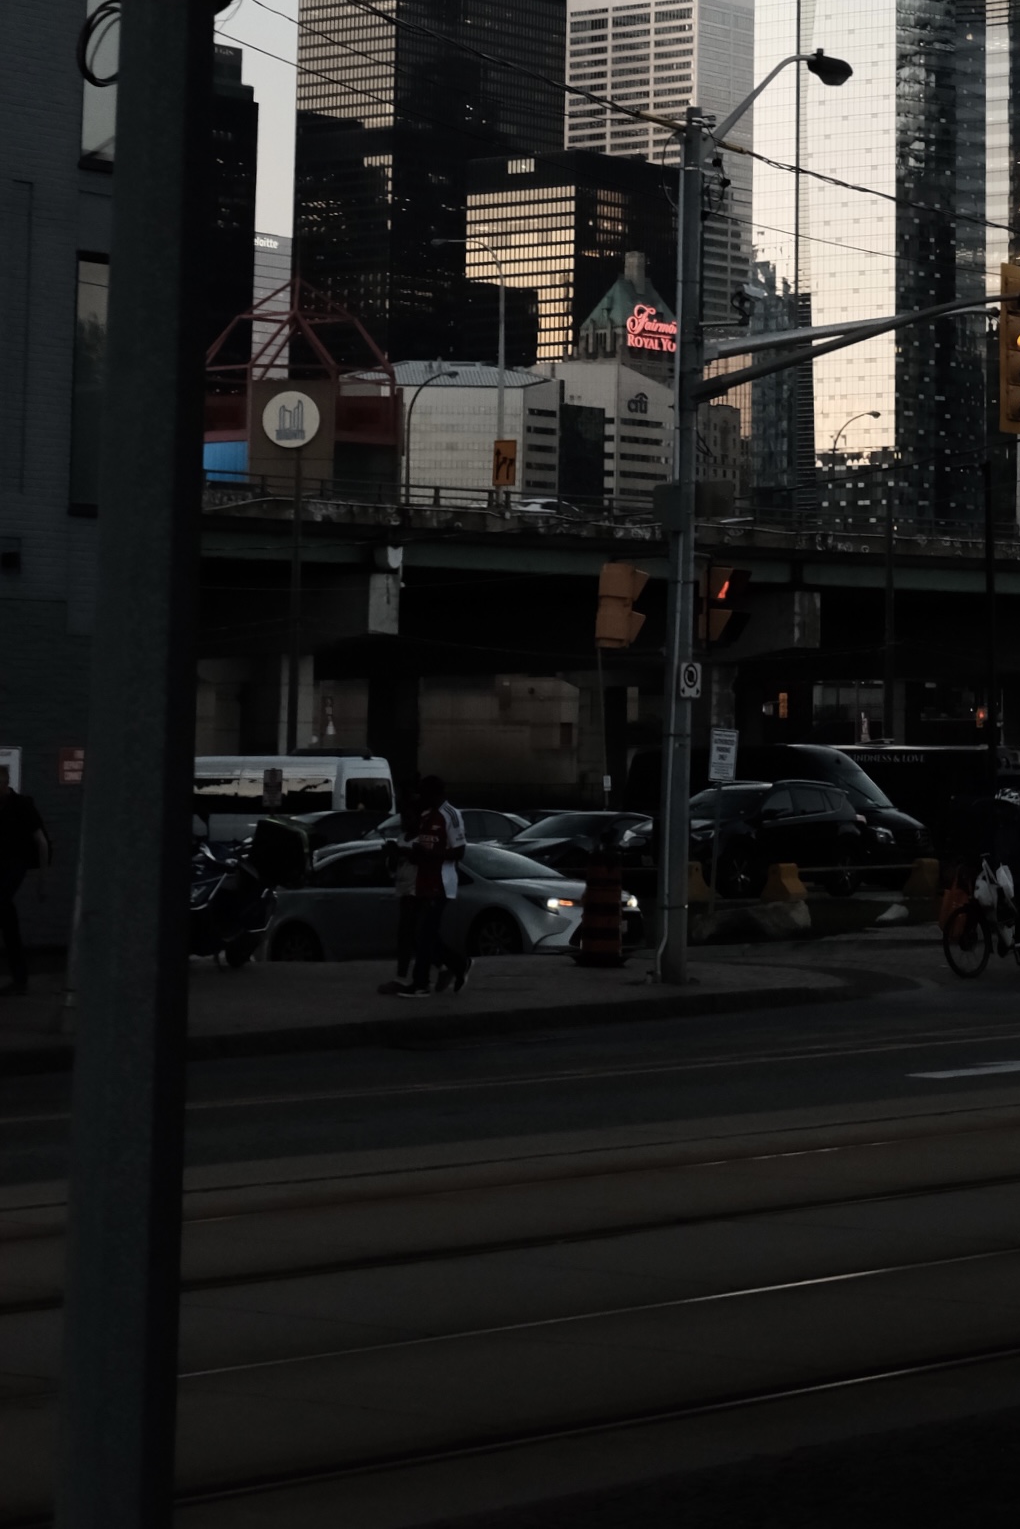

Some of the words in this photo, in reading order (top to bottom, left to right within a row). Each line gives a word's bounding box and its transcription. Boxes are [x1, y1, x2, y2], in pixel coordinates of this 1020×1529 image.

[254, 236, 279, 249] eloitte
[626, 334, 661, 351] ROYAL
[660, 338, 677, 353] YO
[627, 391, 648, 414] citi
[852, 754, 892, 763] INDNESS
[893, 754, 900, 763] &
[902, 754, 925, 763] LOVE
